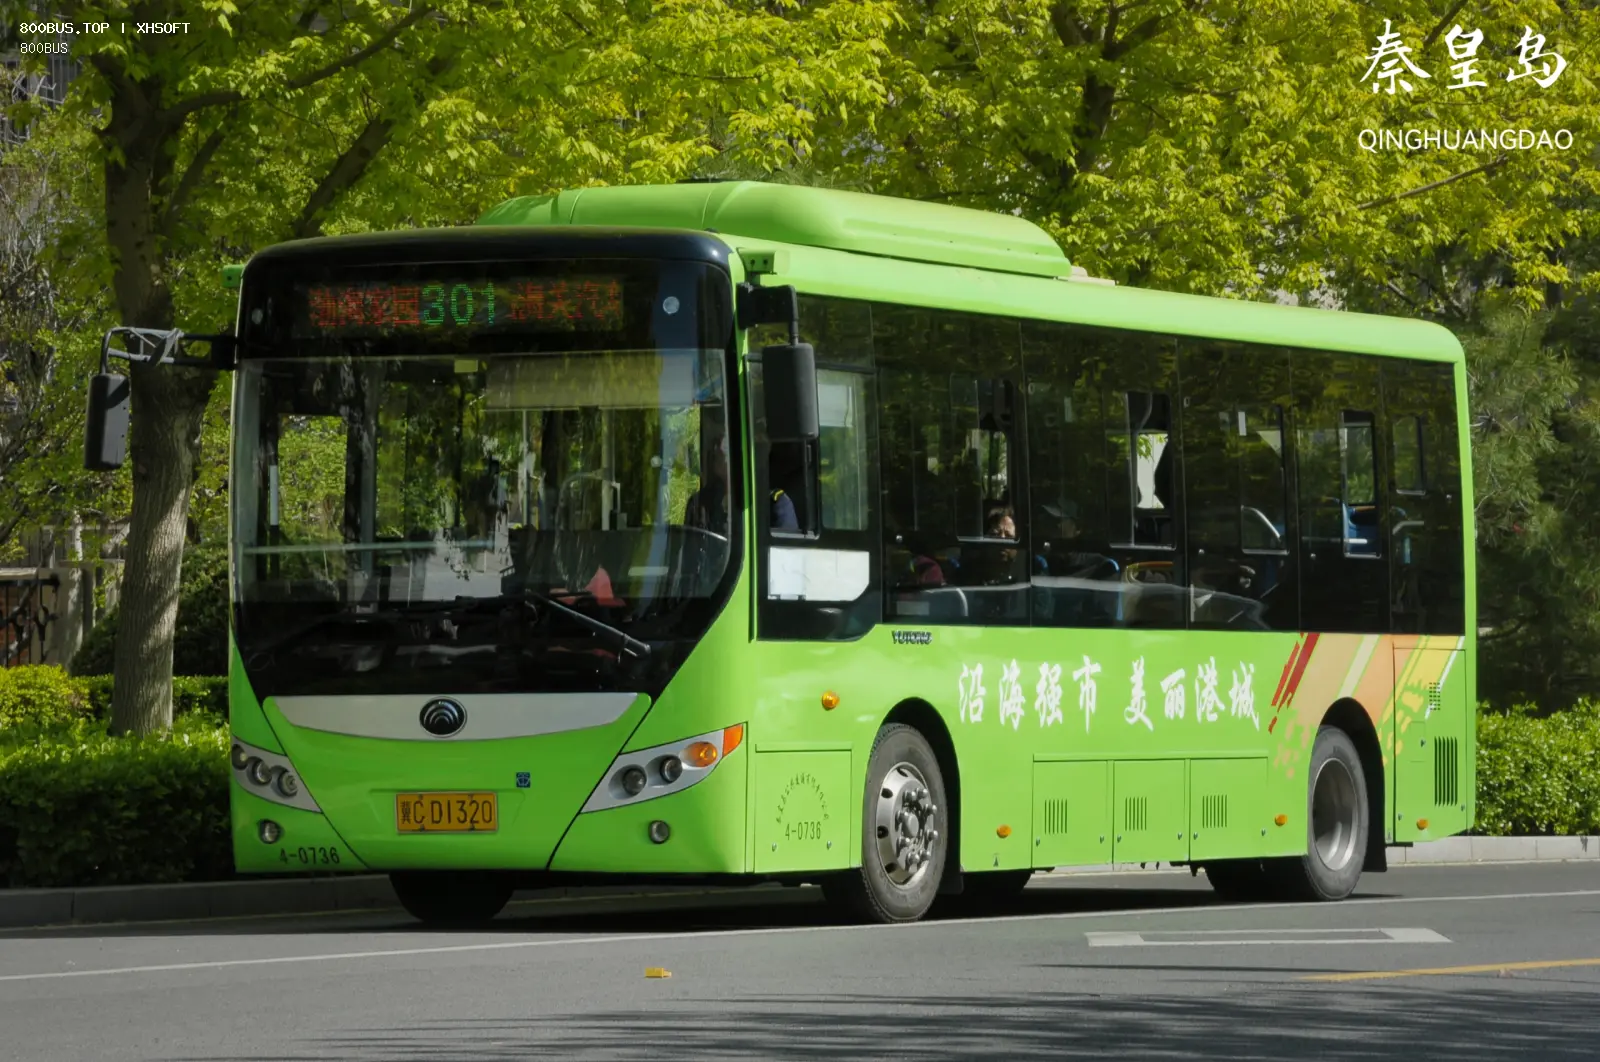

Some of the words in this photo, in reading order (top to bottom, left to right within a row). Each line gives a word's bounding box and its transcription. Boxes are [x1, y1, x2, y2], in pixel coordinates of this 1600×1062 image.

[422, 281, 495, 325] 301
[959, 655, 1101, 733] 沿海强市
[1124, 655, 1259, 732] 美丽港城
[785, 821, 821, 840] 4-0736
[279, 847, 340, 864] 4-0736
